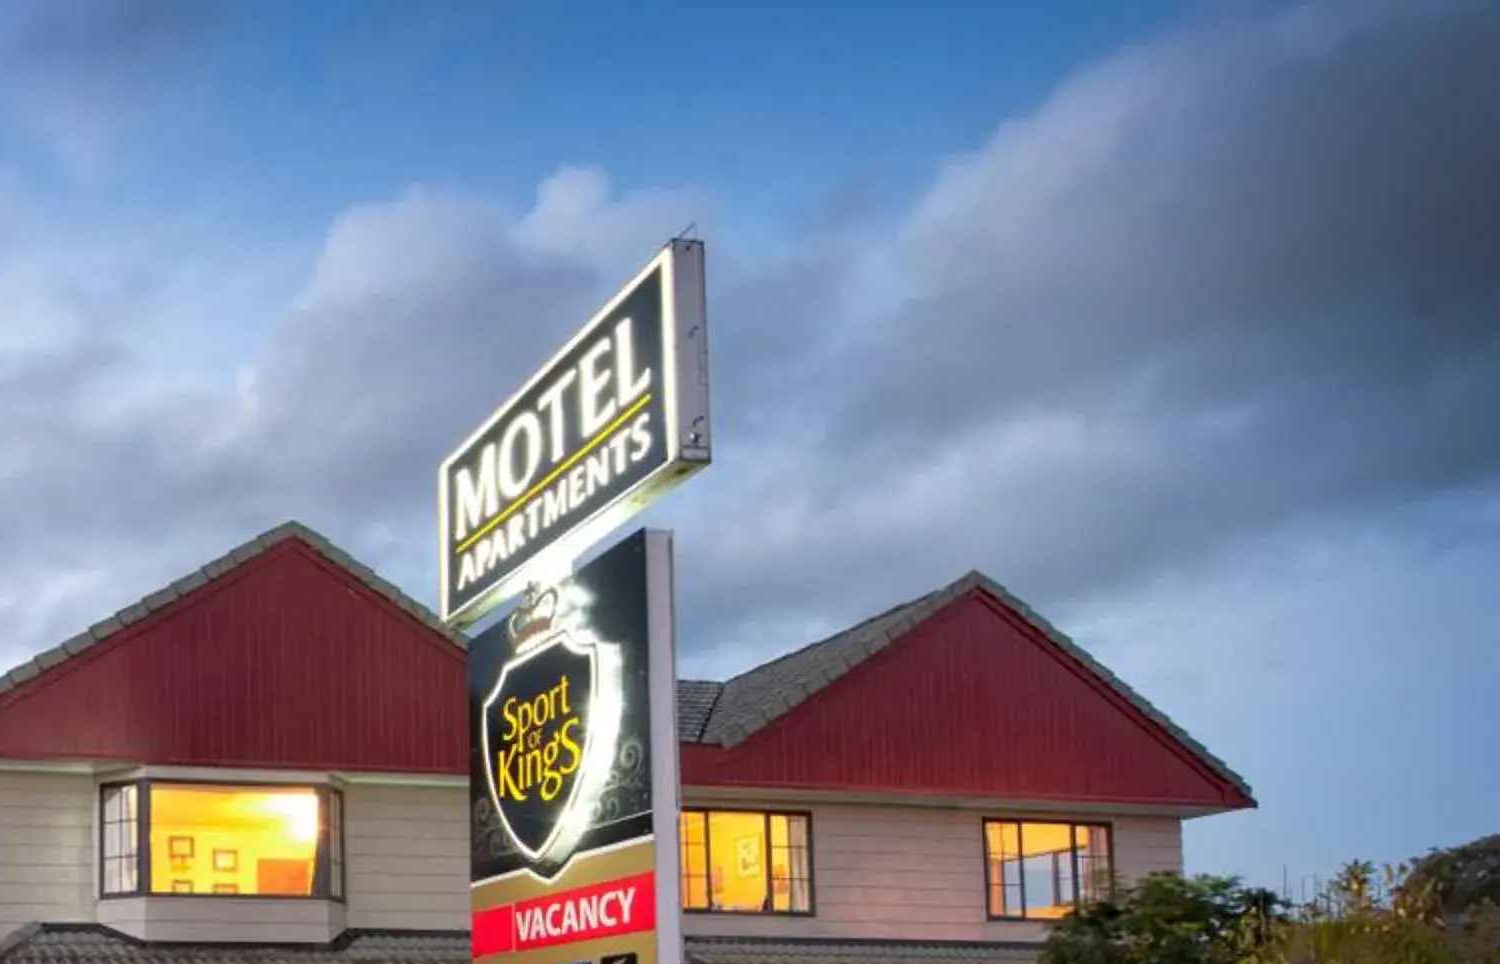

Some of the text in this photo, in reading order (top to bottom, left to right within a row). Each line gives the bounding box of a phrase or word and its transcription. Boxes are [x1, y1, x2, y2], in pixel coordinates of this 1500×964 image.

[455, 317, 652, 541] MOTEL
[457, 413, 652, 590] APARTMENTS
[504, 675, 570, 752] Sport
[516, 887, 636, 941] VACANCY
